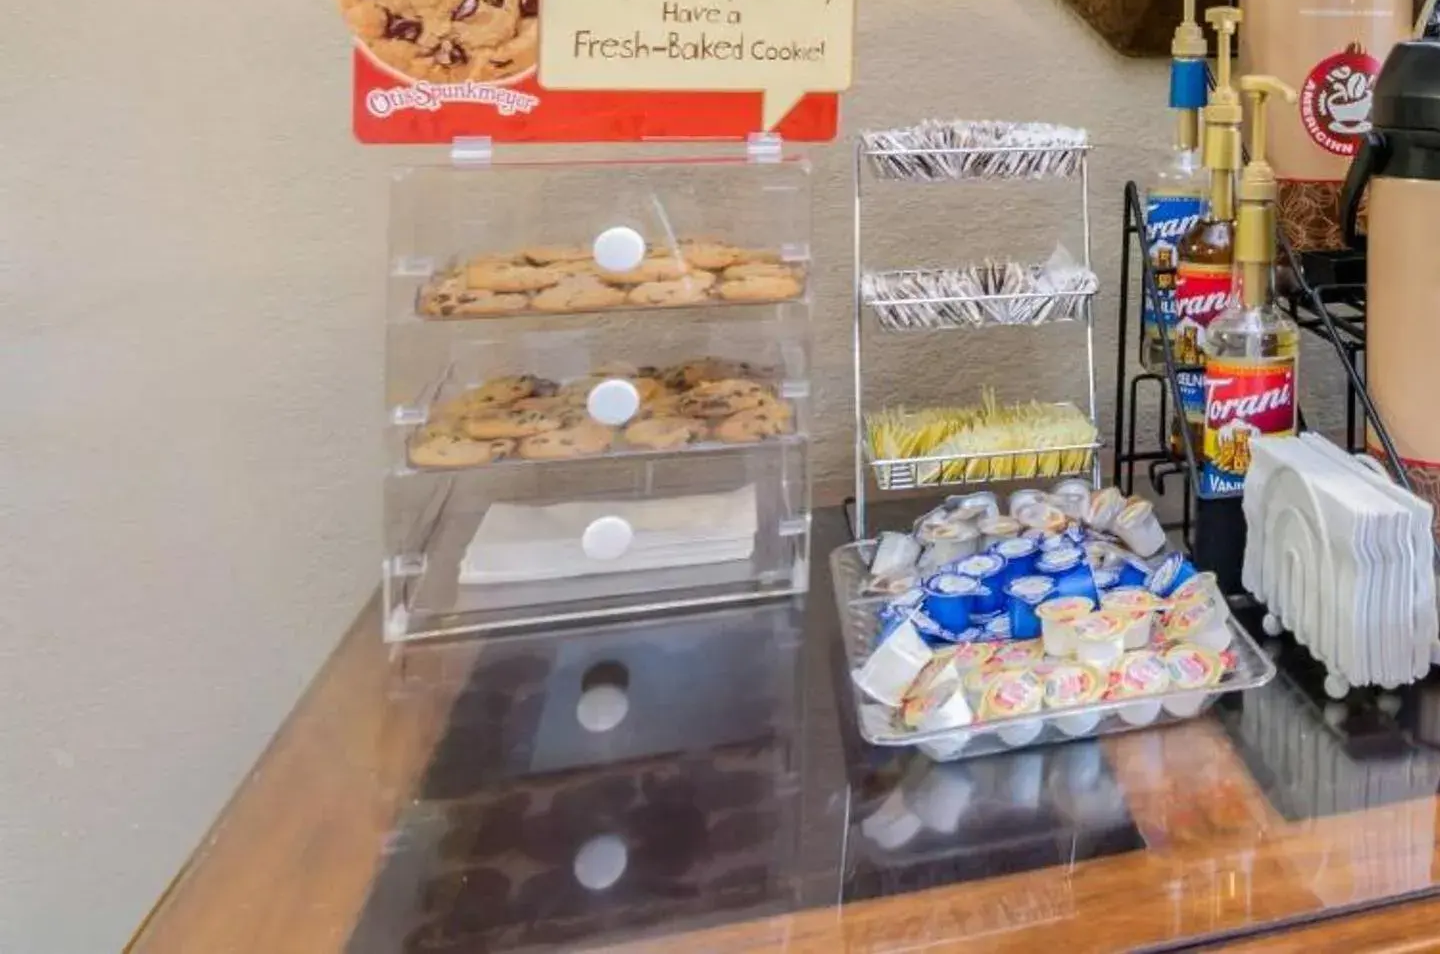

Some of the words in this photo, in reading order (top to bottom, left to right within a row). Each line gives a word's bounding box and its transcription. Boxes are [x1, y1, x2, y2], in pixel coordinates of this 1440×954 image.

[661, 1, 721, 24] Have
[727, 9, 742, 25] a
[573, 29, 744, 61] Fresh-Baked
[1203, 371, 1291, 424] Torani
